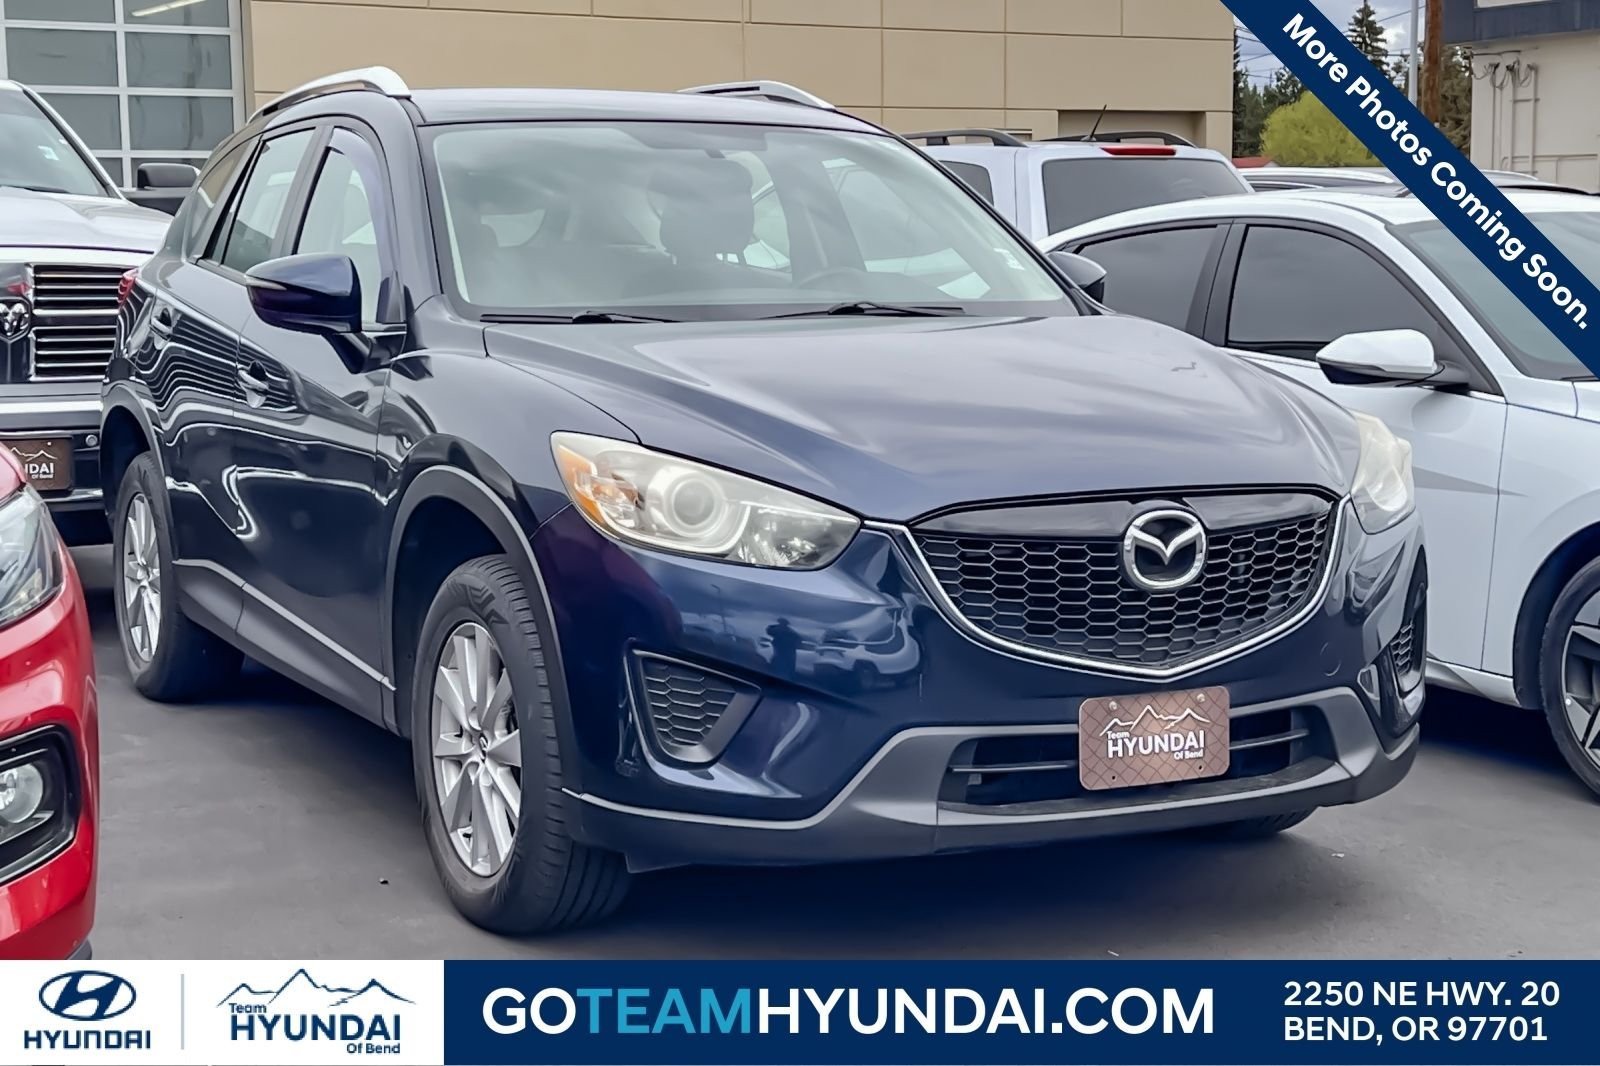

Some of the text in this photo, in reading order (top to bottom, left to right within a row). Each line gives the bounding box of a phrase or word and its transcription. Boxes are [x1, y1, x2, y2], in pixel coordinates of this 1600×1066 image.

[1106, 730, 1130, 740] Team
[1107, 730, 1205, 758] HYUNDAI
[1174, 749, 1203, 760] Of Bend
